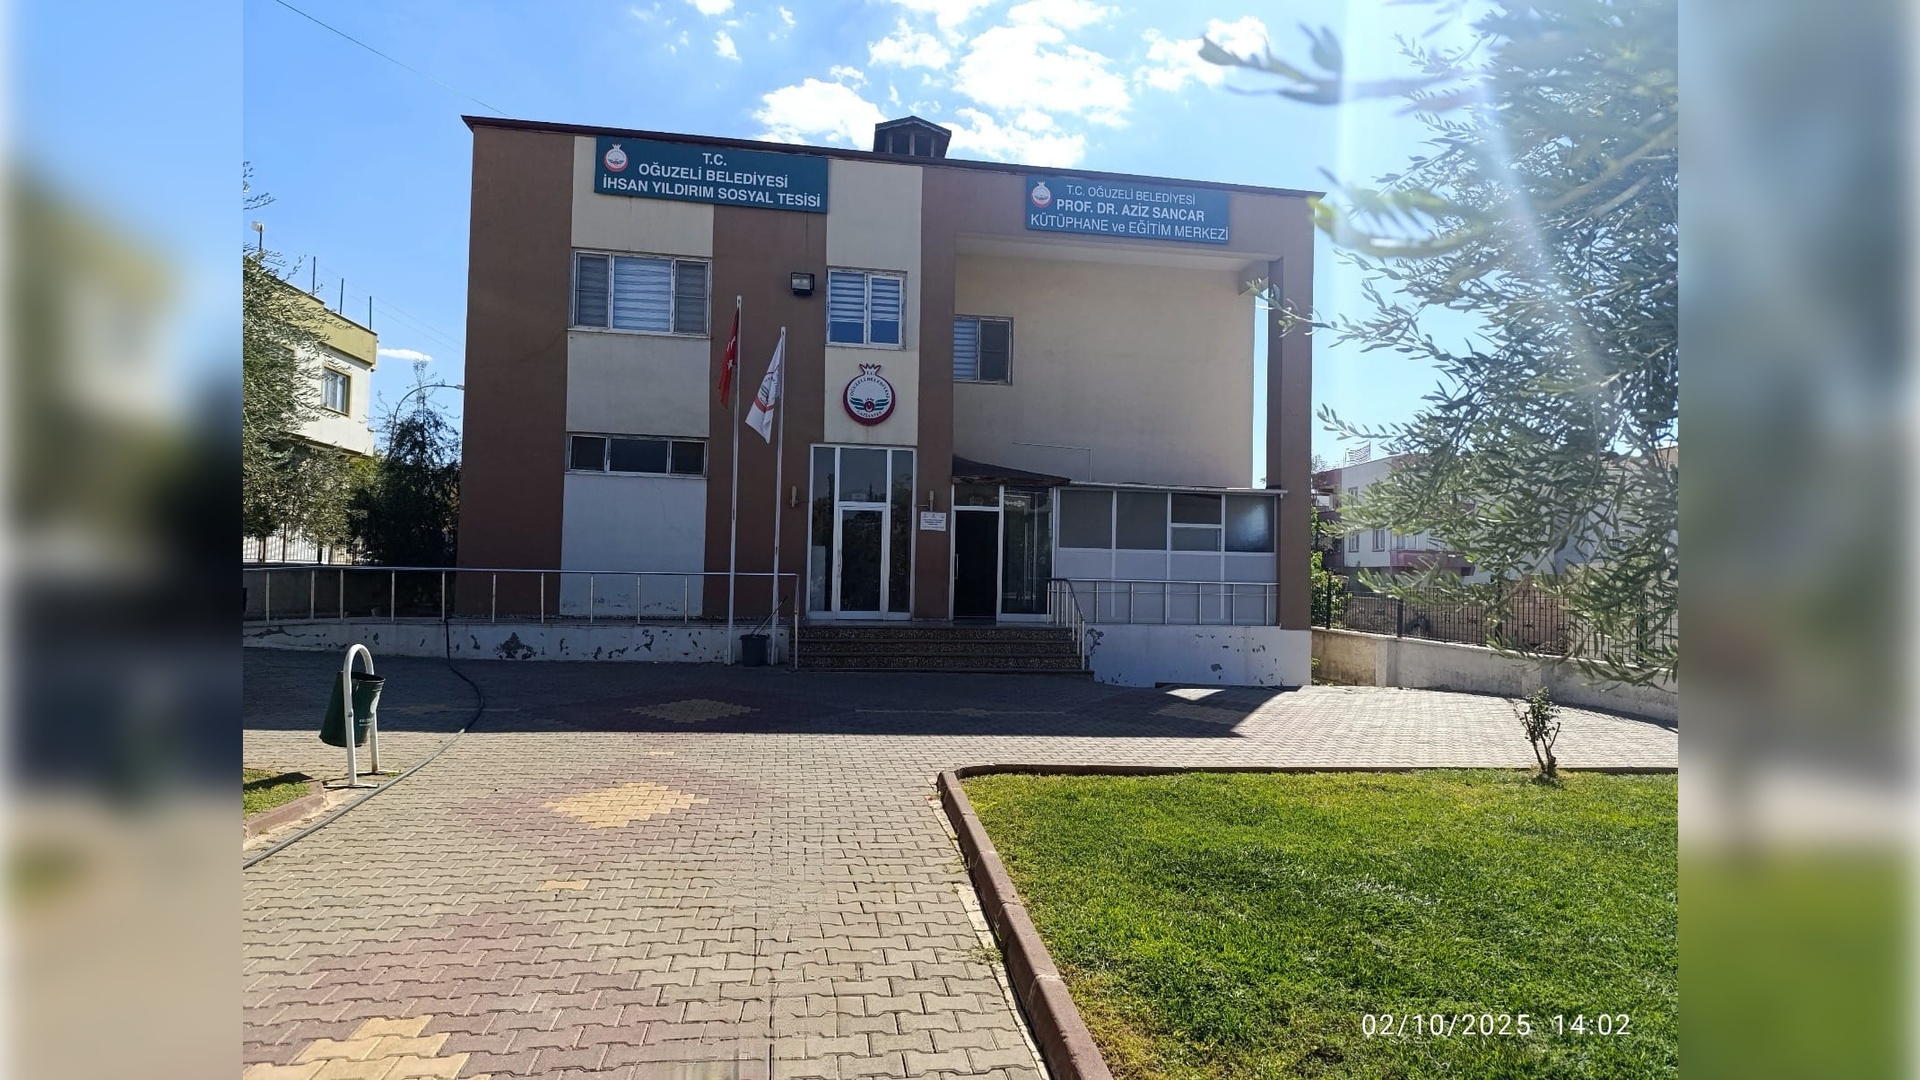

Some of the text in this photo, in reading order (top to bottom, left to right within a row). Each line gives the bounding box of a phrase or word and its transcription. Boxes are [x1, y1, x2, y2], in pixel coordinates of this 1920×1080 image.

[702, 153, 727, 166] T.C.
[638, 162, 788, 188] OĞUZELİ BELEDİYESİ
[603, 174, 821, 207] İHSAN YILDIRIM SOSYAL TESİSİ
[1066, 185, 1085, 196] T.C.
[1087, 185, 1133, 200] OĞUZELİ
[1136, 190, 1196, 205] BELEDİYESİ
[1056, 198, 1205, 222] PROF. DR. AZİZ SANCAR
[1111, 223, 1126, 232] ve
[1129, 220, 1171, 236] EĞİTİM
[1174, 225, 1229, 240] MERKEZİ
